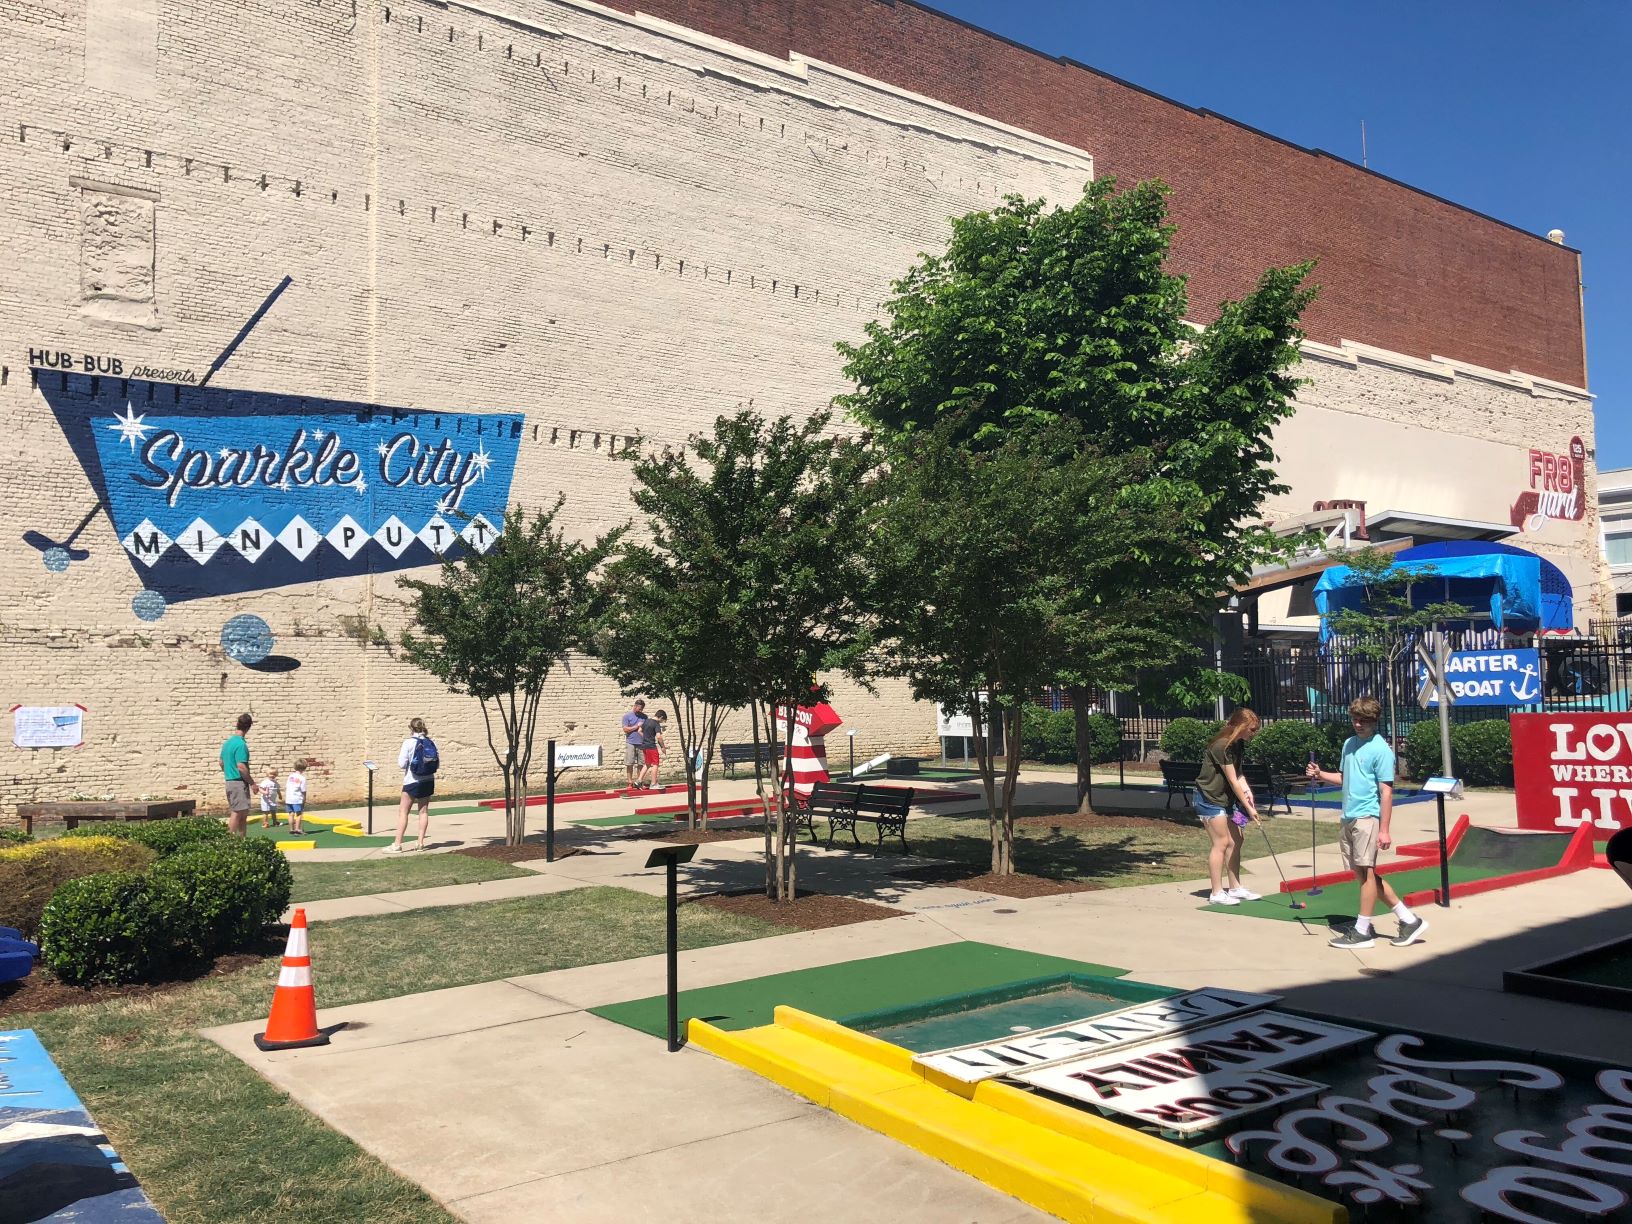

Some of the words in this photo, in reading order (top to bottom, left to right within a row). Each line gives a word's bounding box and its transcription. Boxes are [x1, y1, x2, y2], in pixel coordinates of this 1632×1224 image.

[29, 347, 124, 375] HUB-BUB
[130, 364, 198, 383] presents
[129, 429, 364, 508] Sparkle
[379, 431, 480, 514] City
[1528, 448, 1574, 494] FR8
[1529, 484, 1579, 531] yard
[1443, 654, 1518, 673] ARTER
[1450, 680, 1503, 697] BOAT
[557, 752, 595, 764] Information
[1550, 764, 1632, 782] WHER
[1066, 1022, 1329, 1100] FAMILY
[1134, 1077, 1302, 1123] YOUR
